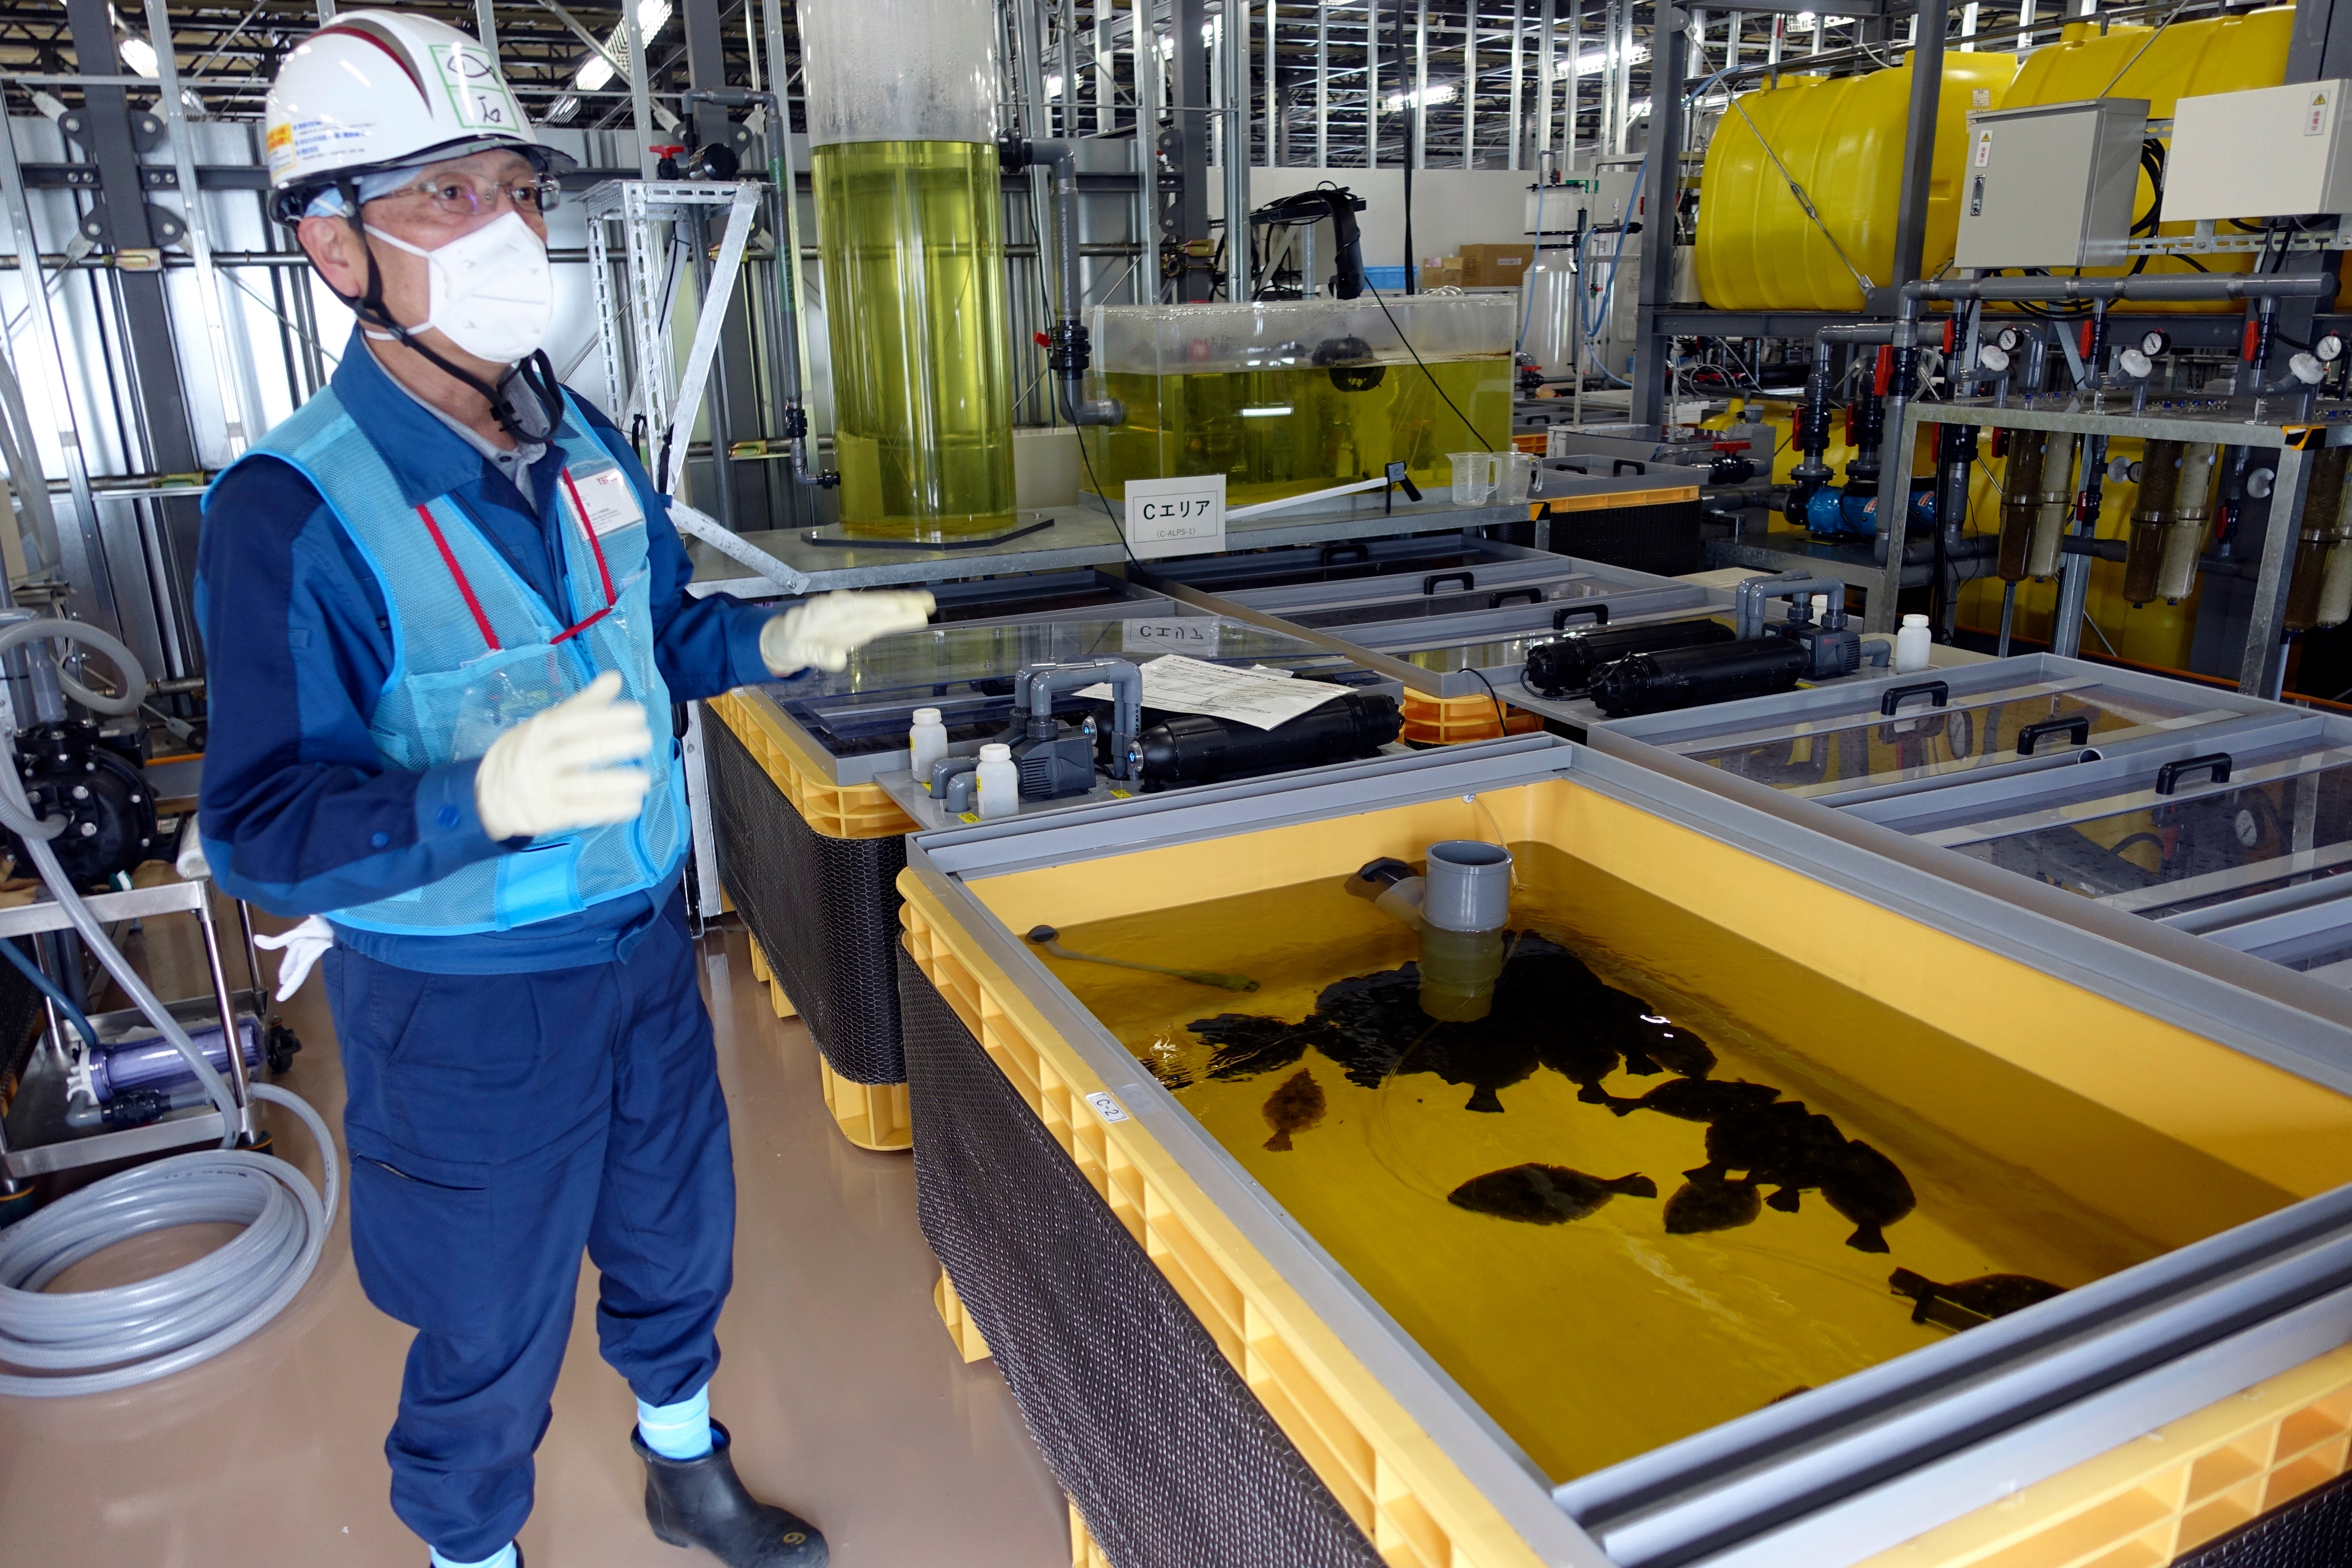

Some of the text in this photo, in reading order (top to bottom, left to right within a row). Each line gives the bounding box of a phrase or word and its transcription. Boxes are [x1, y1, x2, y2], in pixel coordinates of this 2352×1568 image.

[1143, 500, 1210, 520] Cエリア
[1157, 527, 1195, 539] (C-ALPS-1)
[1096, 1099, 1119, 1116] C-2
